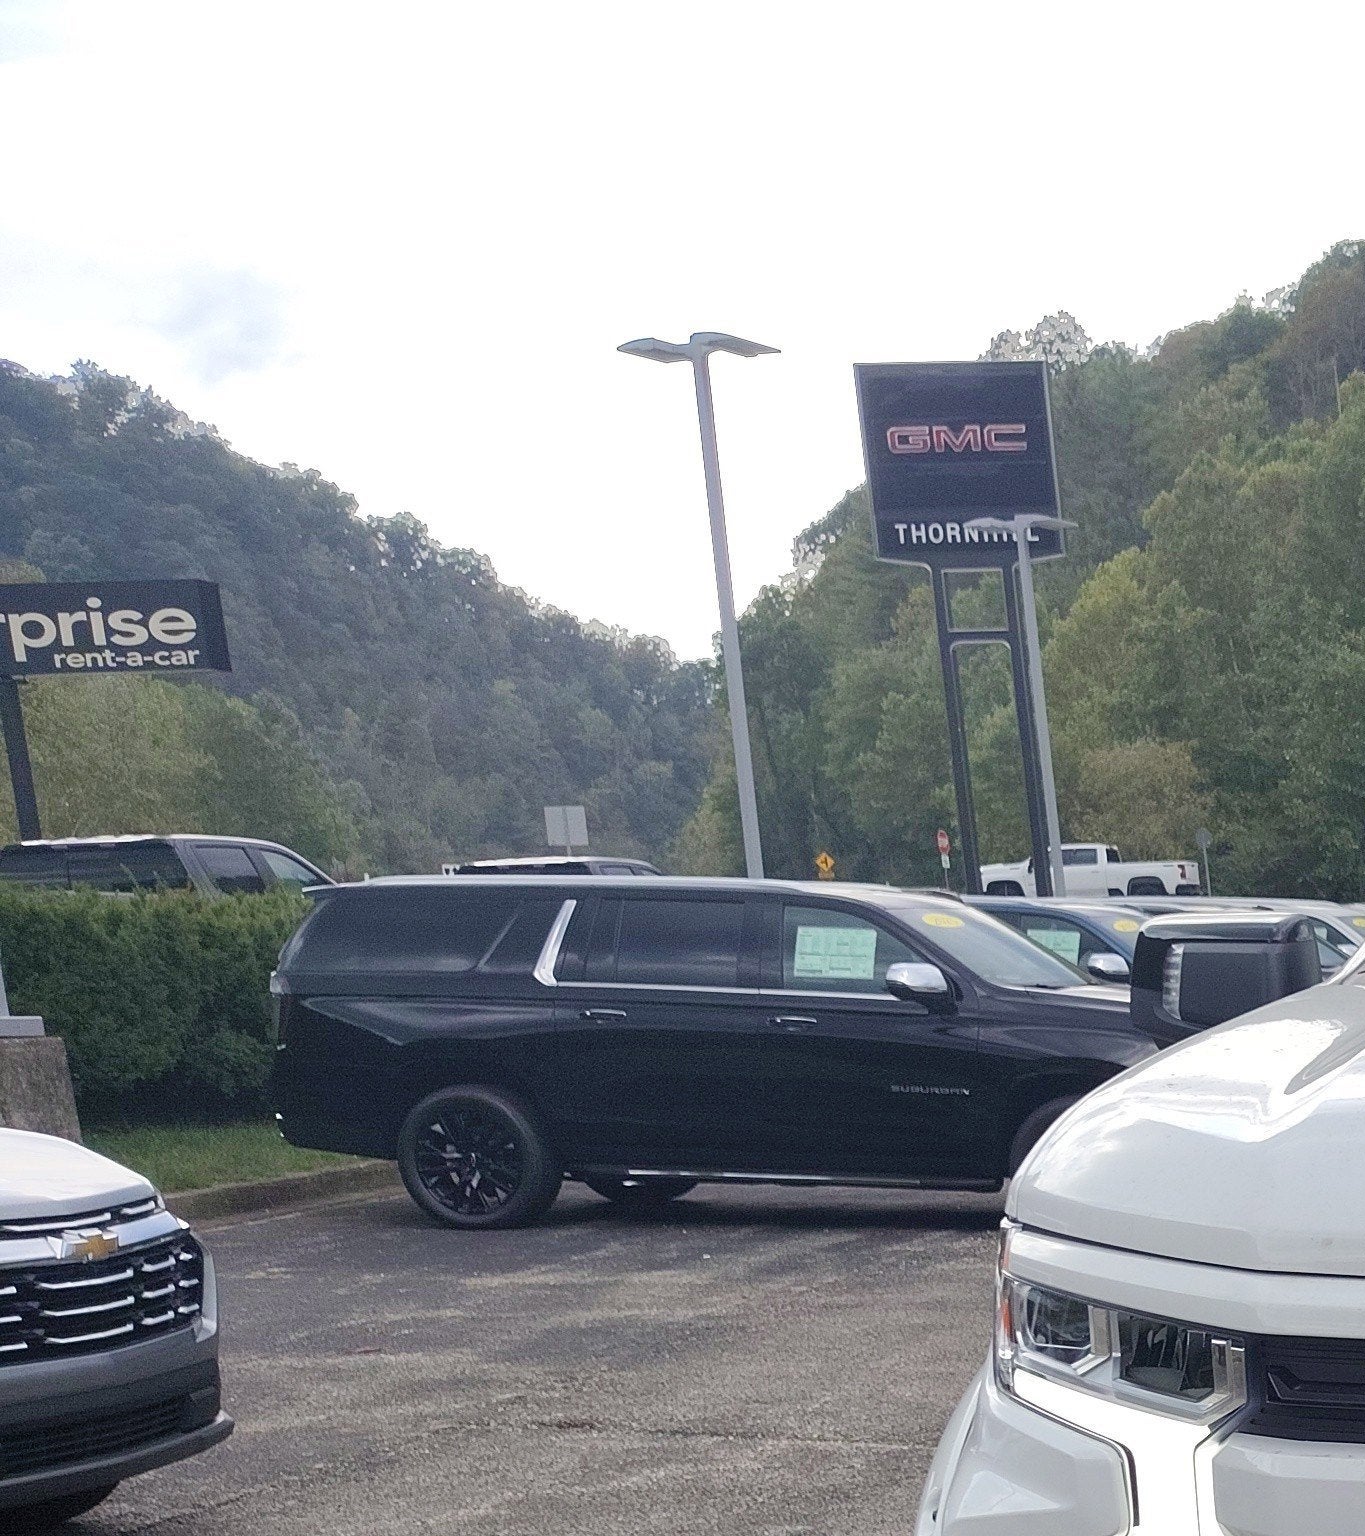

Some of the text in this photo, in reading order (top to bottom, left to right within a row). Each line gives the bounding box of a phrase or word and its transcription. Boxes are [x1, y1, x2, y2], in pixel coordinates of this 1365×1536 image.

[886, 423, 1028, 455] GMC
[894, 522, 1040, 545] THORNL
[0, 597, 197, 662] prise
[53, 649, 200, 668] rent-a-car
